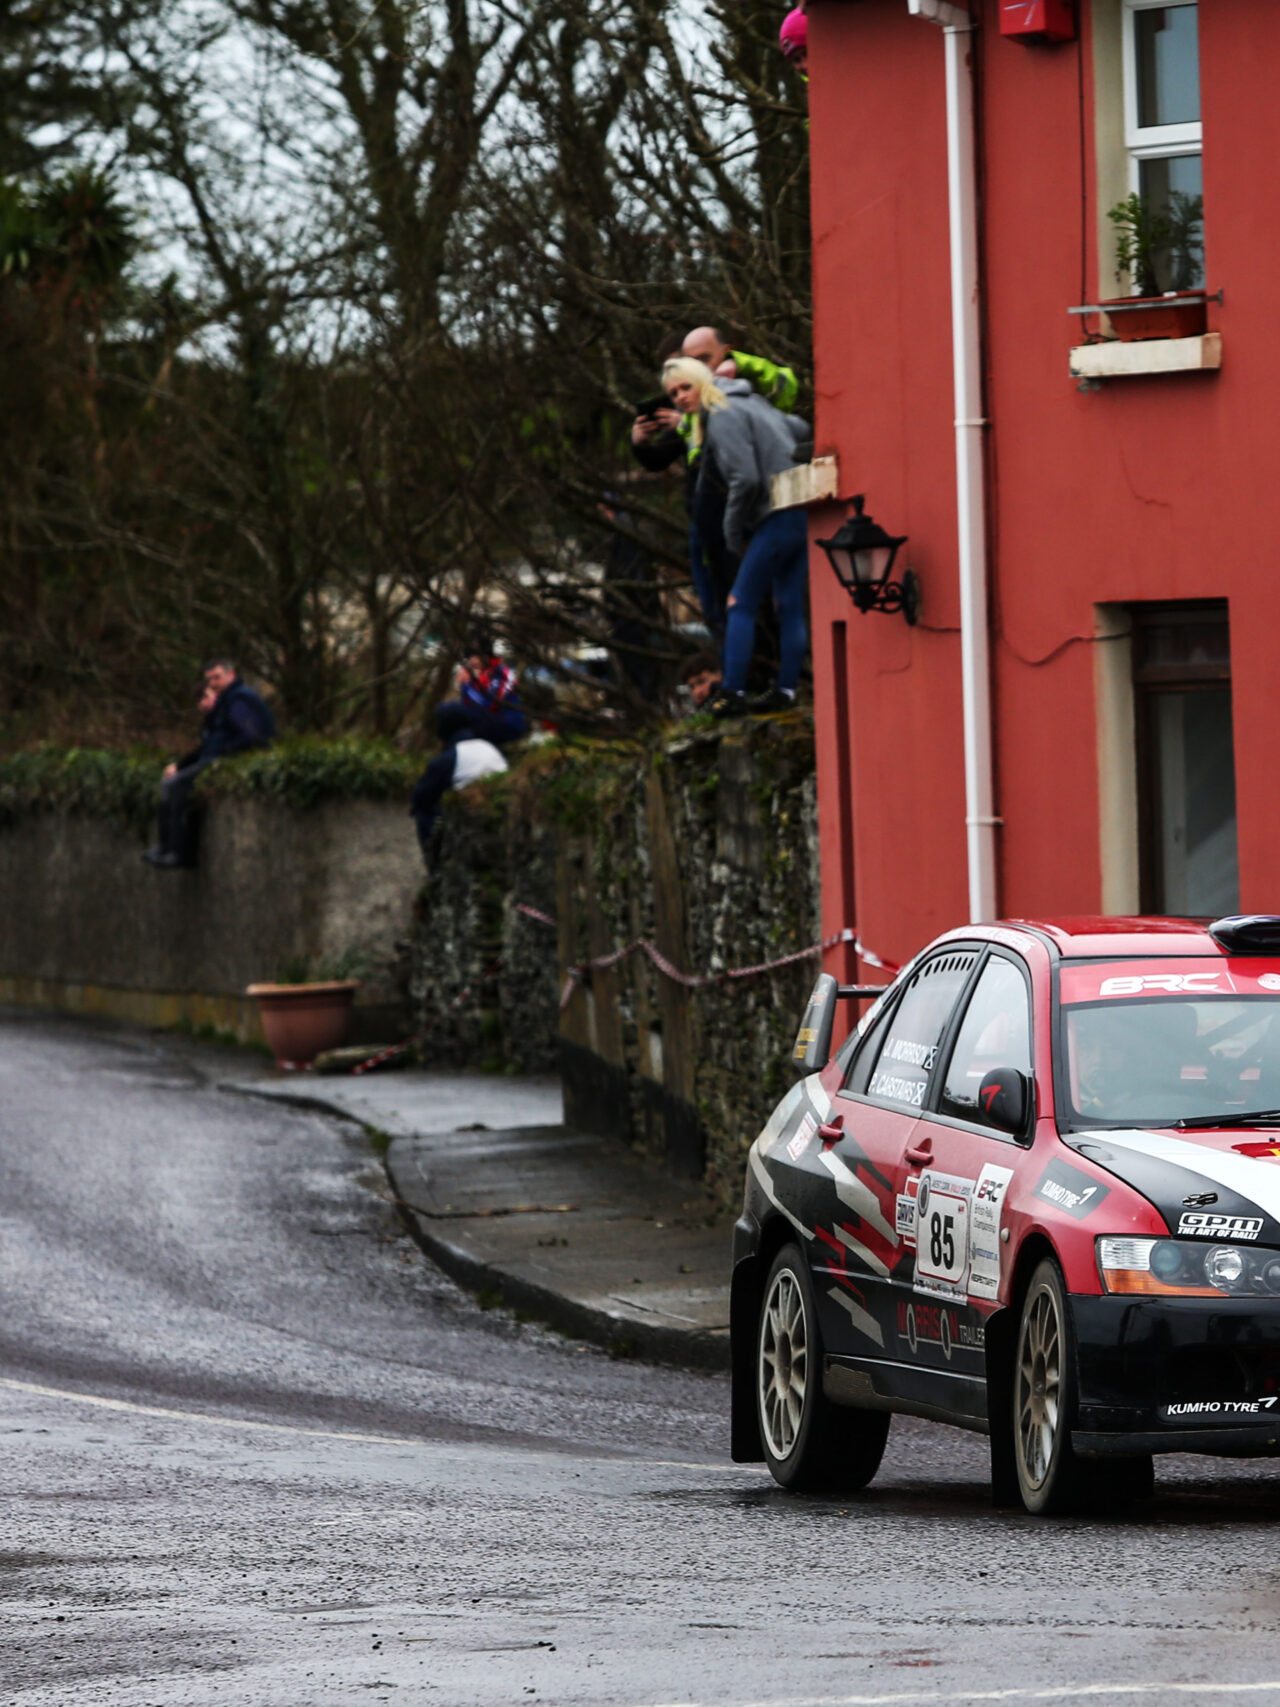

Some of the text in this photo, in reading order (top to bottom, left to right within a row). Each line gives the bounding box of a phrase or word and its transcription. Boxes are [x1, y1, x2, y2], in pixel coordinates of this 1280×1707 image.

[1100, 973, 1220, 995] BRC
[978, 1179, 1003, 1202] BRC
[931, 1212, 954, 1270] 85
[1177, 1226, 1196, 1234] THE
[1196, 1228, 1217, 1236] ART
[1167, 1401, 1260, 1415] KUMHO TYRE
